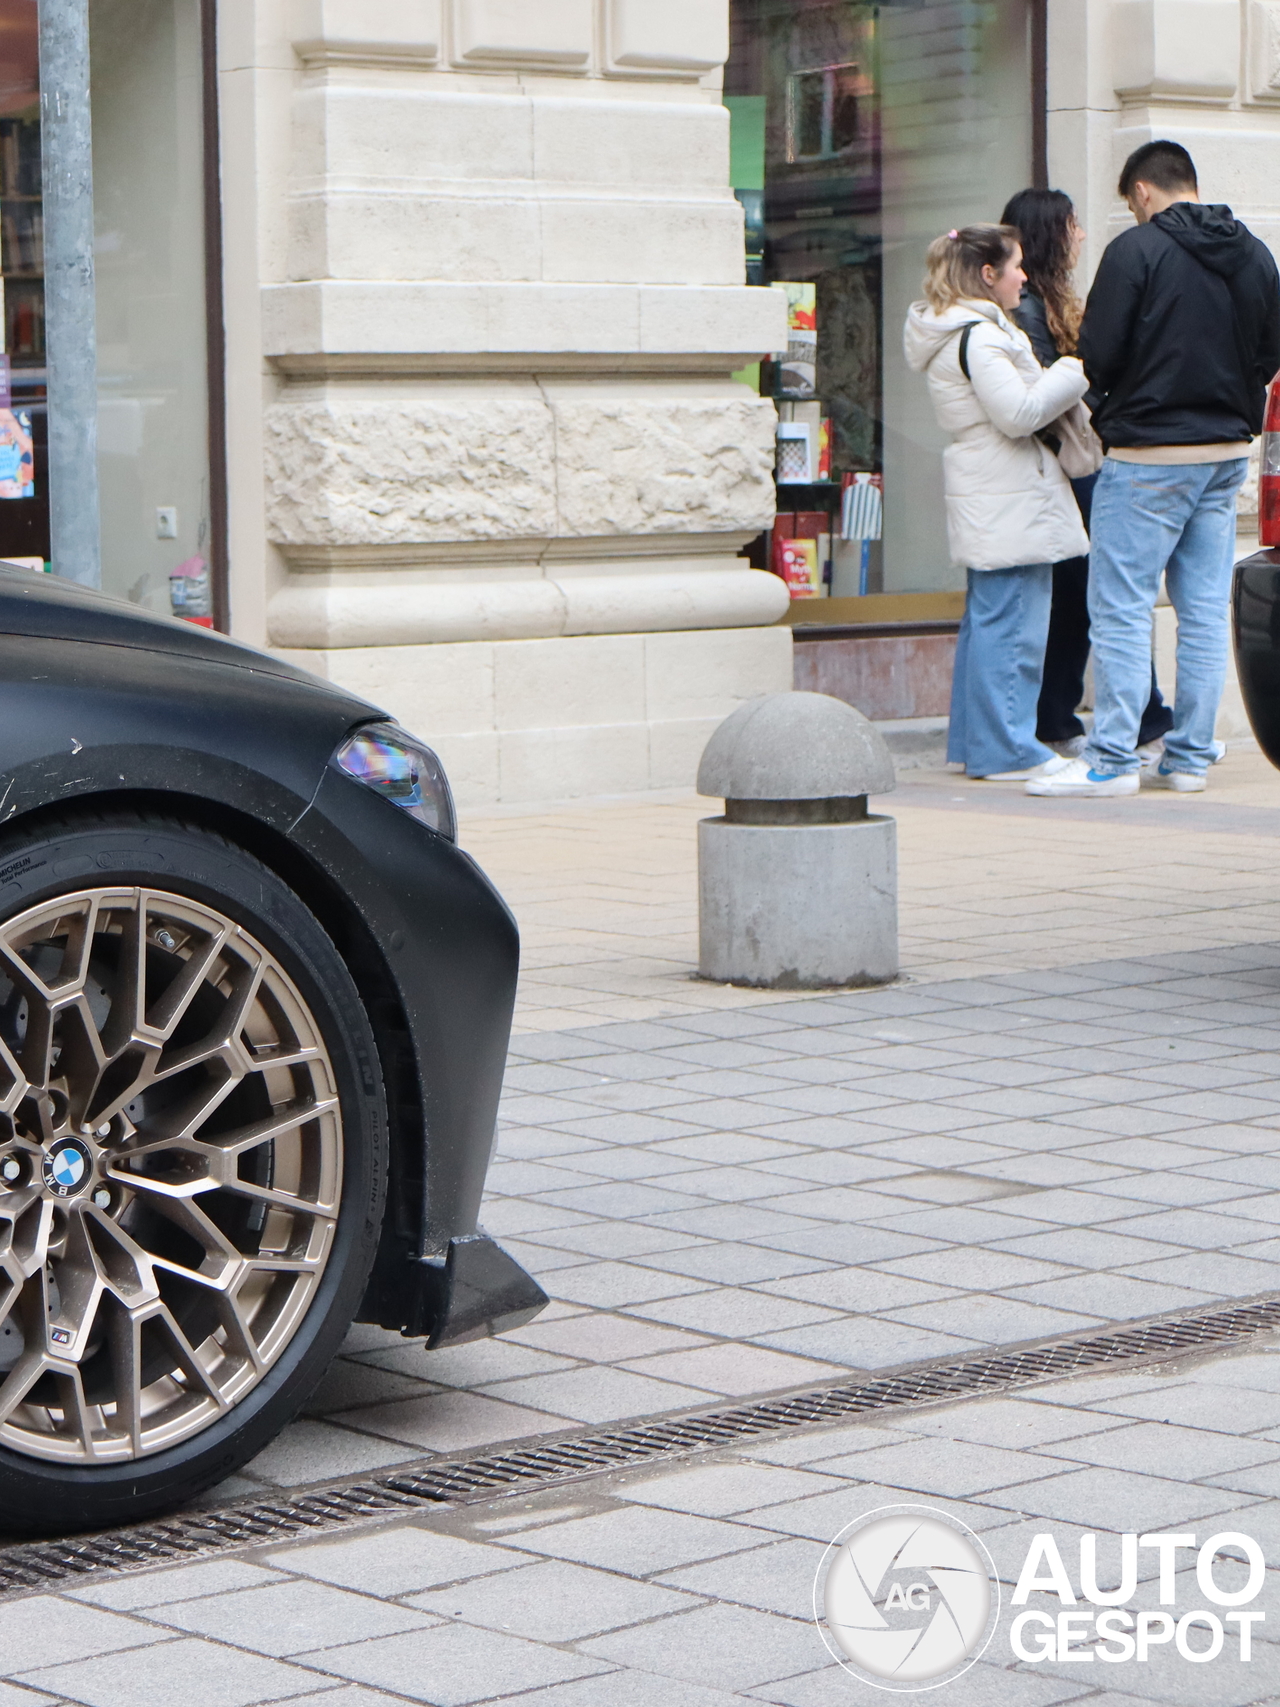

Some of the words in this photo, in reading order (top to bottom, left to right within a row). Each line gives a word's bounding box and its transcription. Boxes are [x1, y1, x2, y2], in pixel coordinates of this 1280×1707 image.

[1, 874, 14, 885] Total
[14, 859, 48, 878] Performance
[371, 1110, 380, 1151] PILOT
[371, 1158, 380, 1203] ALPIN
